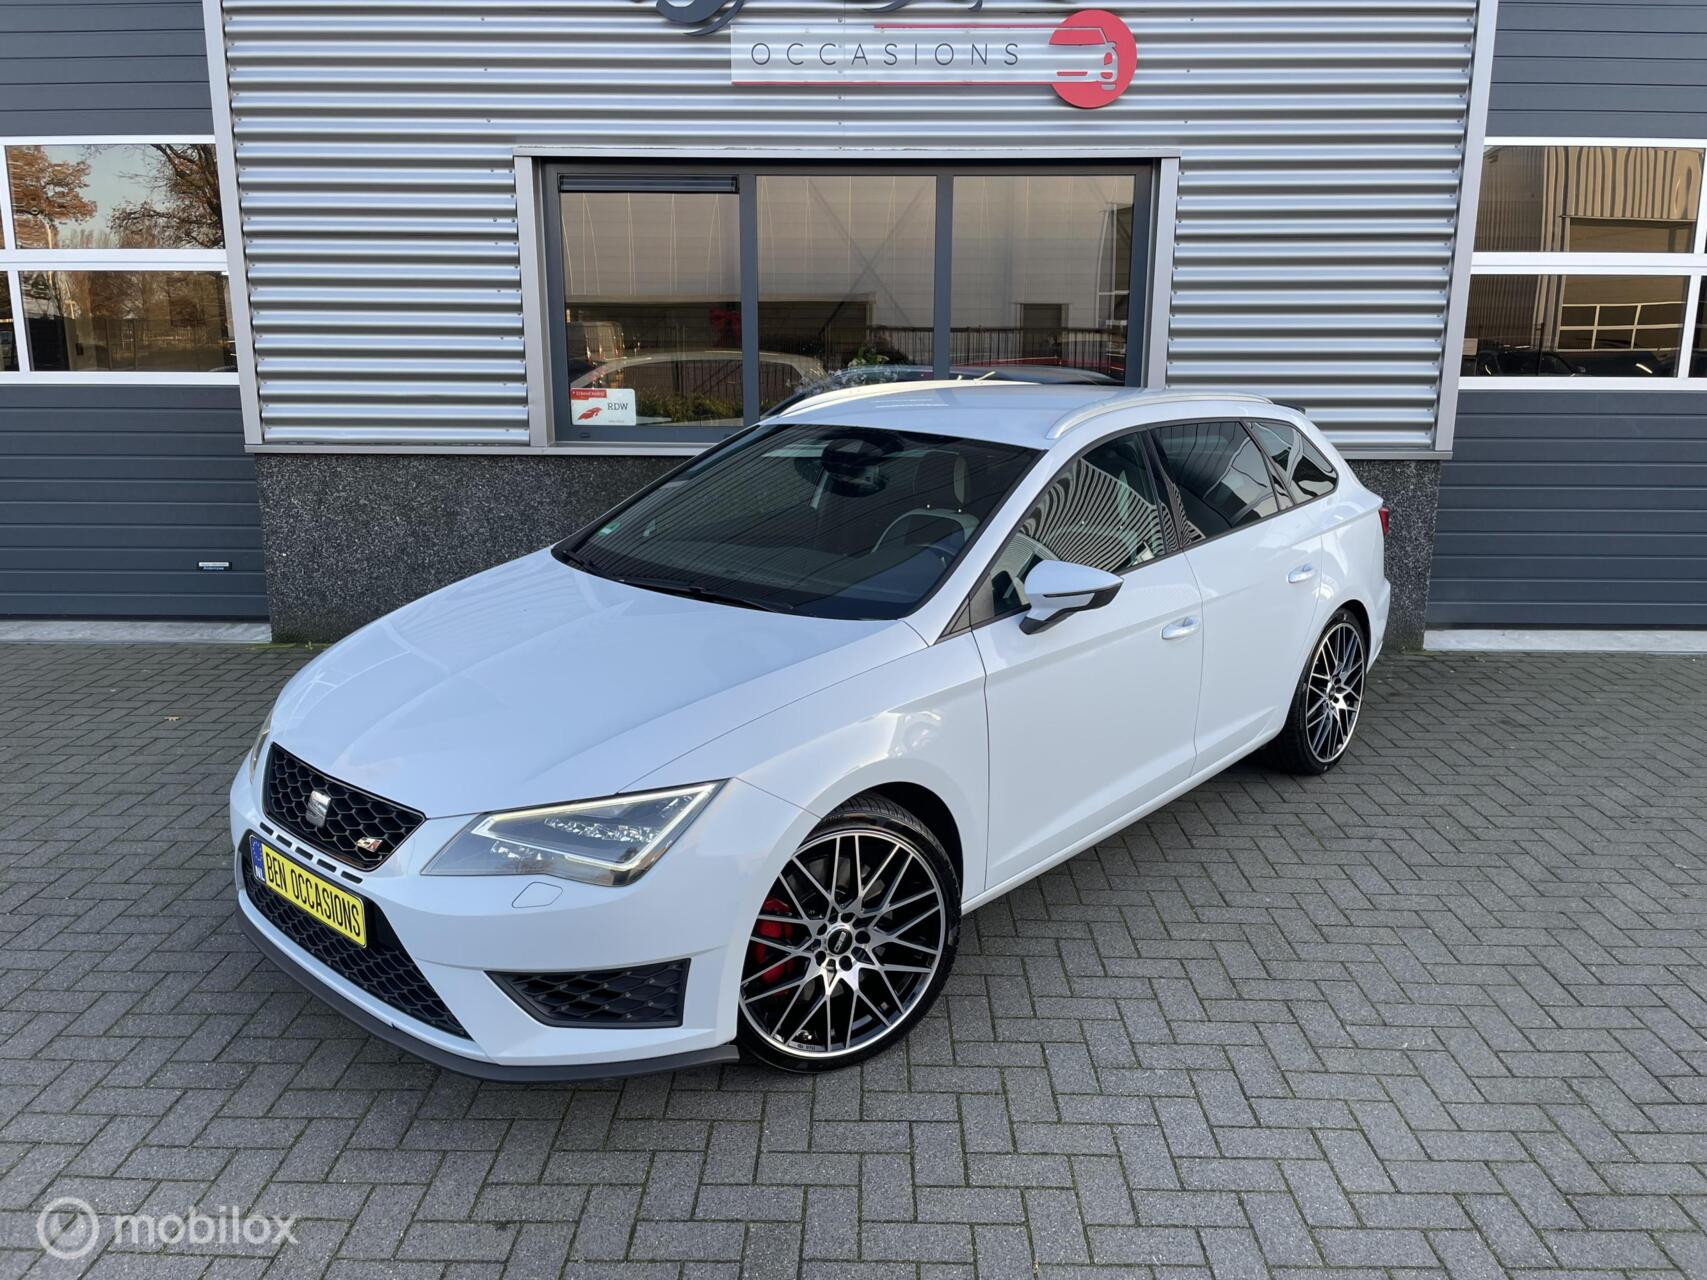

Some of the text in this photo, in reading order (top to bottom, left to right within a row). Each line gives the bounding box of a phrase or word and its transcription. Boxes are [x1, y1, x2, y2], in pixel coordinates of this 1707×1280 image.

[751, 43, 1019, 66] OCCASIONS
[607, 402, 629, 411] RDW
[266, 853, 361, 937] BEN OCCASIONS
